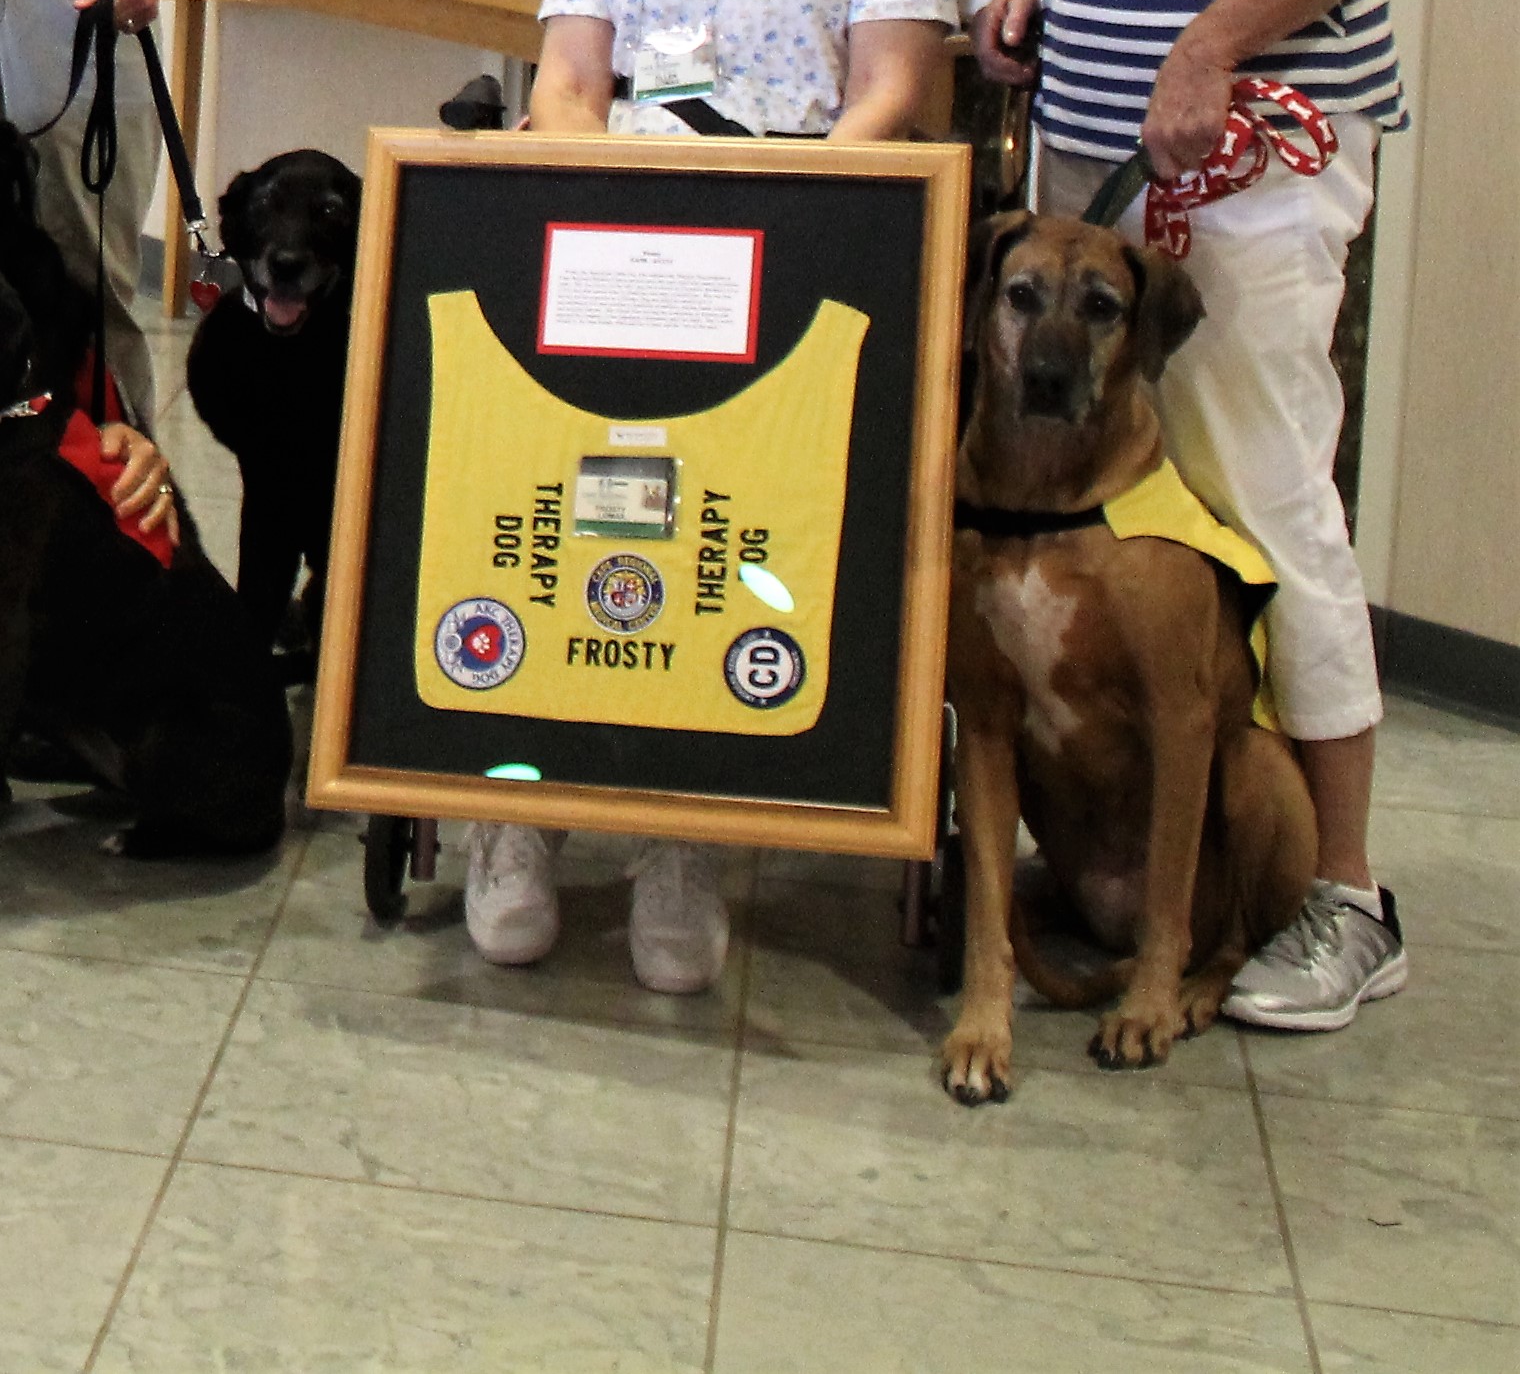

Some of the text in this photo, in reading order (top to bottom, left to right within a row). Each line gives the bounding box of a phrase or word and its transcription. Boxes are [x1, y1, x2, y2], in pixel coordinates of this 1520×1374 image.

[493, 515, 523, 567] DOG
[529, 483, 563, 607] THERAPY
[695, 489, 731, 616] THERAPY
[738, 529, 769, 581] OG
[475, 603, 500, 617] AKC
[567, 637, 676, 671] FROSTY
[749, 646, 780, 689] CD
